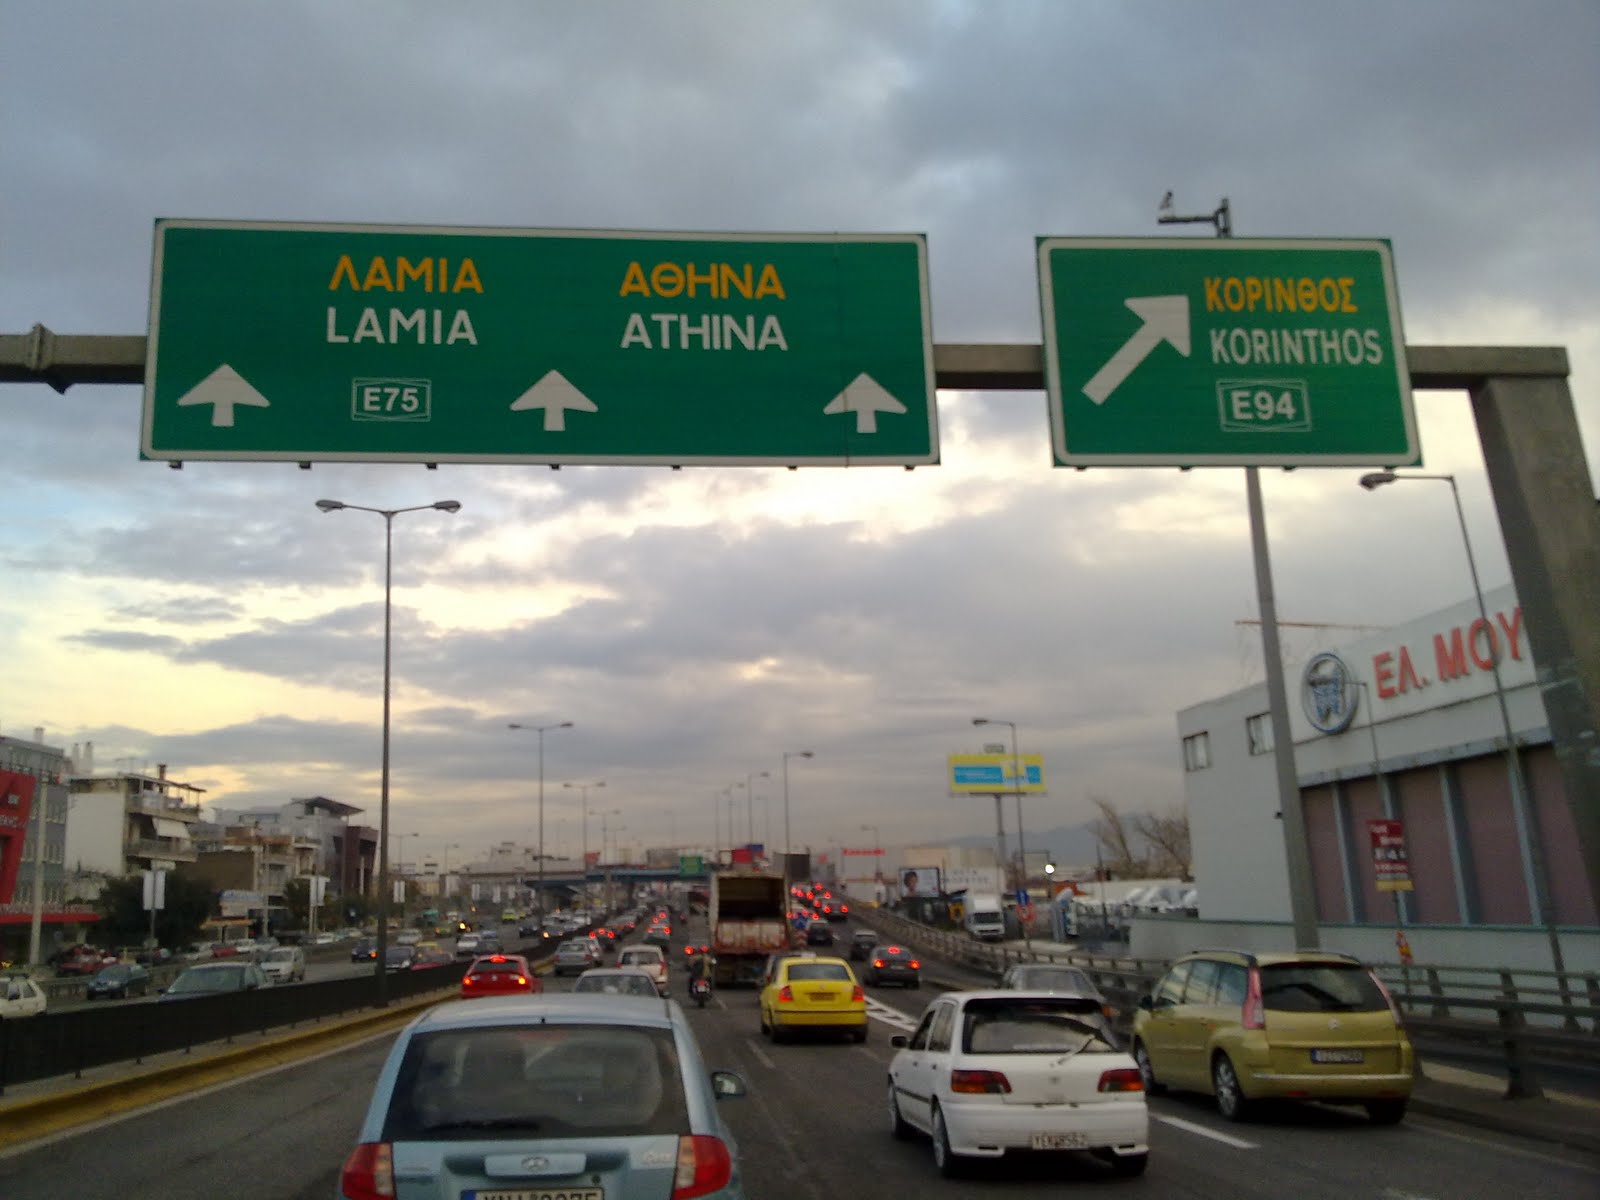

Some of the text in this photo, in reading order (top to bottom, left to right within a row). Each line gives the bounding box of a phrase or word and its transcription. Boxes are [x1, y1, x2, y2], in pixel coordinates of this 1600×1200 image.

[328, 254, 483, 294] ΛΑΜΙΑ
[619, 261, 786, 300] ΑΘΗΝΑ
[1204, 276, 1359, 313] ΚΟΡΙΝΘΟΣ
[326, 306, 478, 346] LAMIA
[621, 312, 788, 351] ATHINA
[1210, 328, 1383, 365] KORINTHOS
[362, 386, 420, 413] E75
[1231, 390, 1297, 421] E94
[1372, 645, 1430, 699] ΕΛ.
